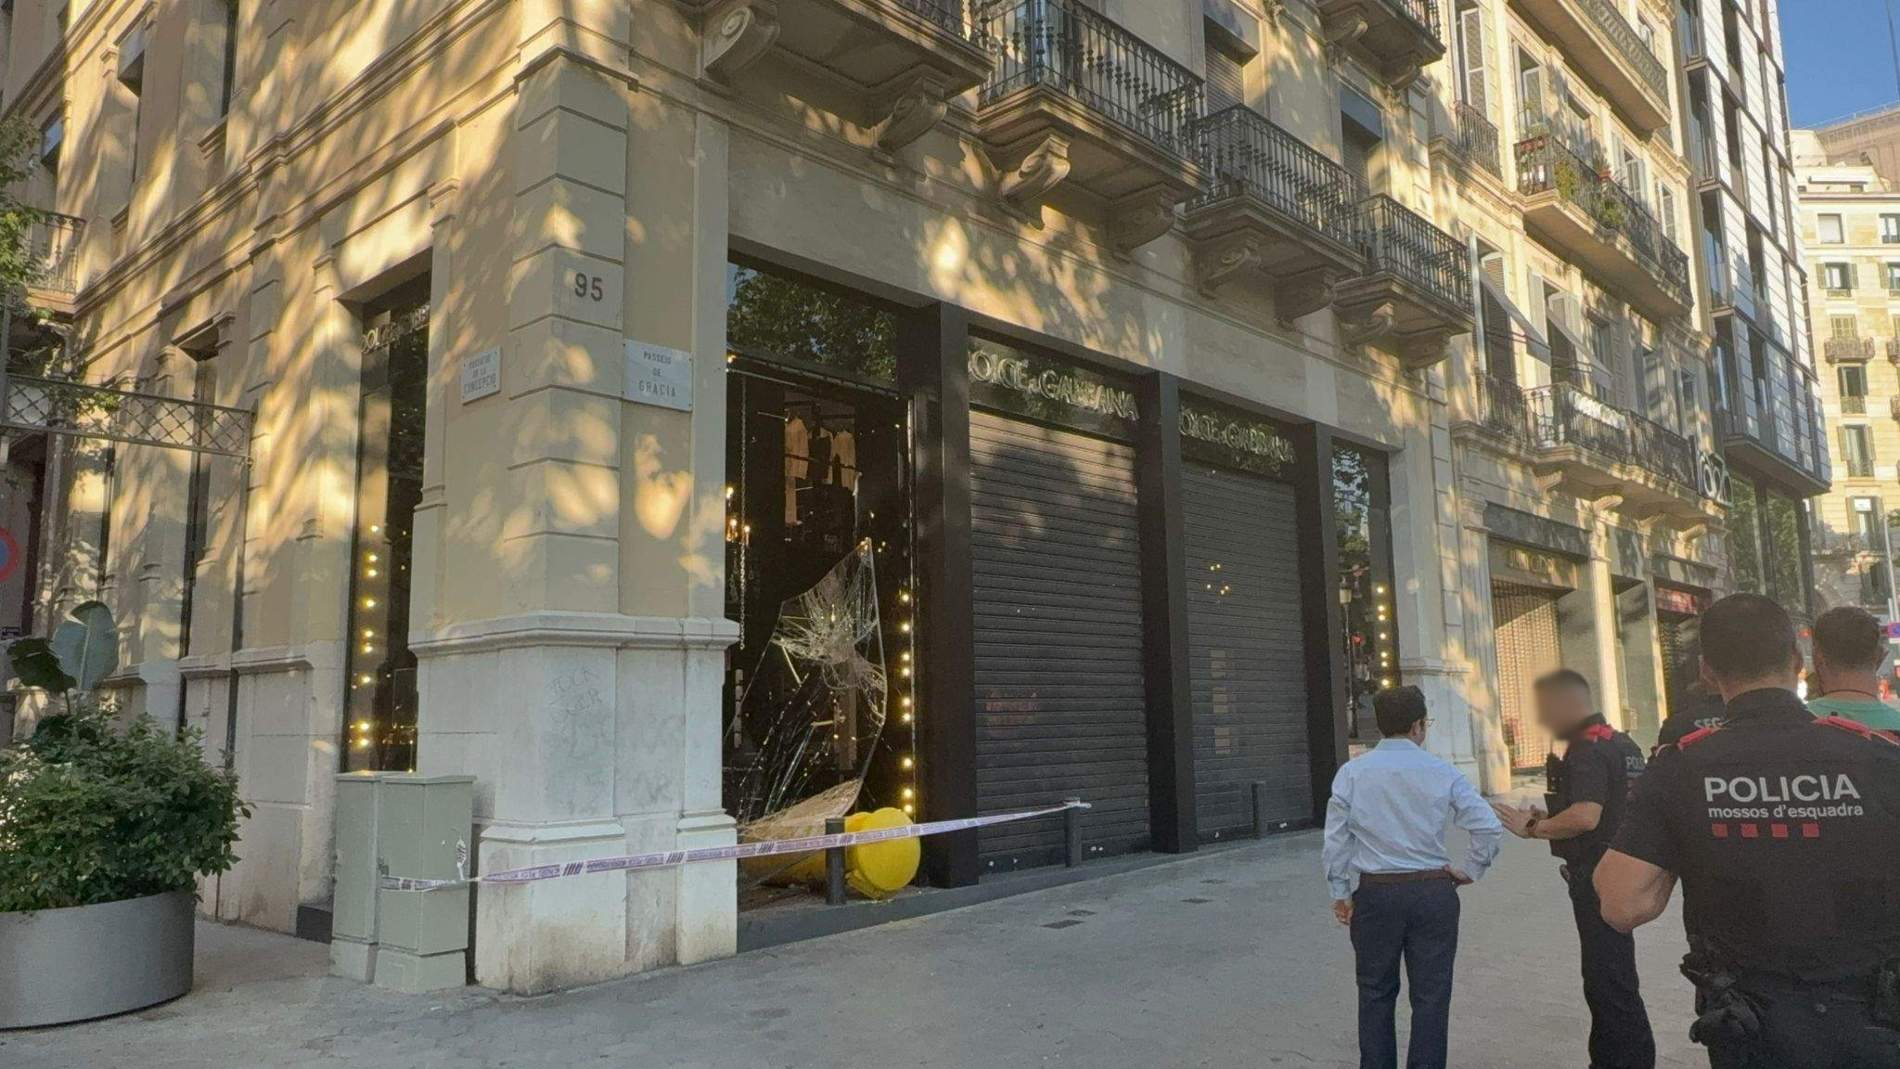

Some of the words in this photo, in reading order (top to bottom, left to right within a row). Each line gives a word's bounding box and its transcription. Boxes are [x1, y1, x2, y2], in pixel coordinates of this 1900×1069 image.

[574, 272, 604, 303] 95
[1704, 773, 1862, 803] POLICIA
[1708, 806, 1769, 819] mossos
[1774, 803, 1864, 819] d'esquadra
